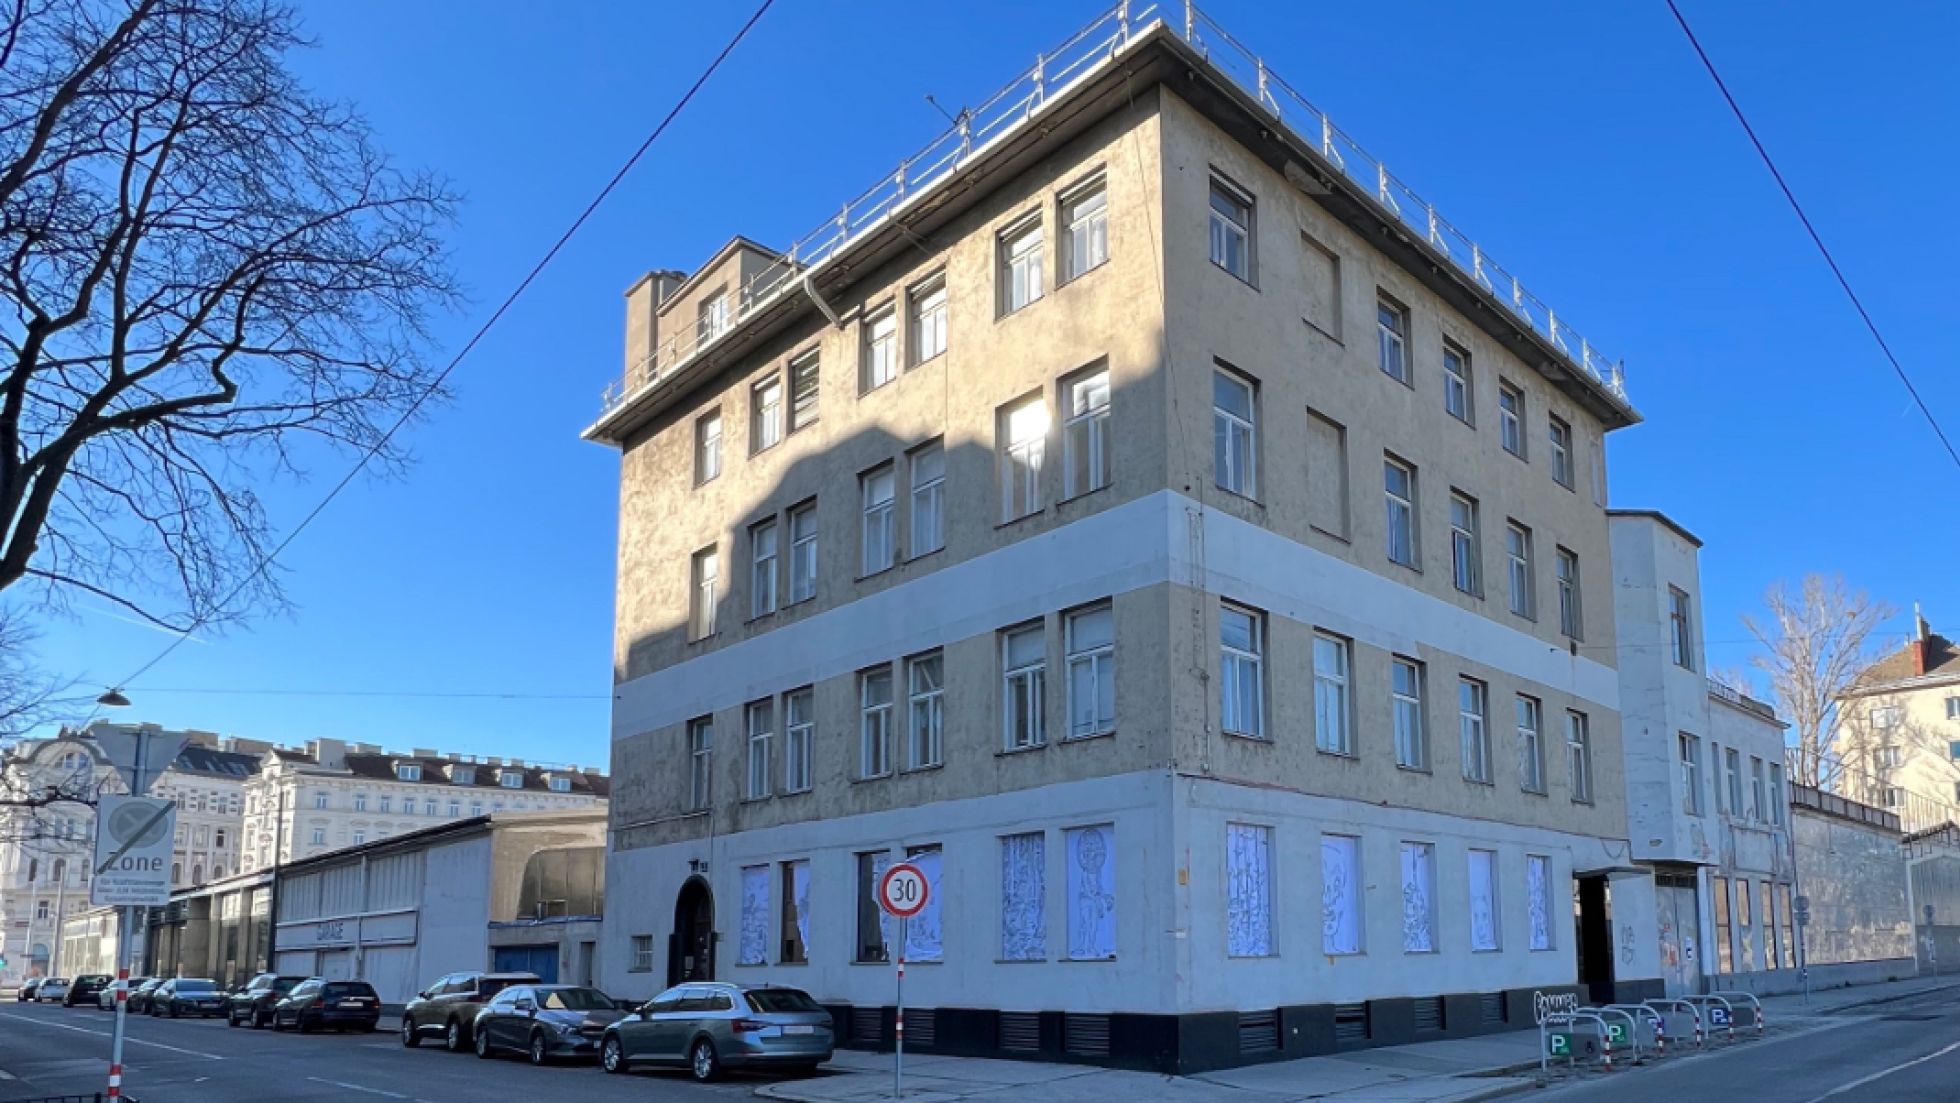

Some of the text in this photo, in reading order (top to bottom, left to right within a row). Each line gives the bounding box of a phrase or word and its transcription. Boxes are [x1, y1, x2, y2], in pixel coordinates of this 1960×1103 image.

[107, 851, 162, 871] Zone
[894, 879, 916, 902] 30
[1608, 1025, 1622, 1041] P
[1551, 1034, 1566, 1054] P
